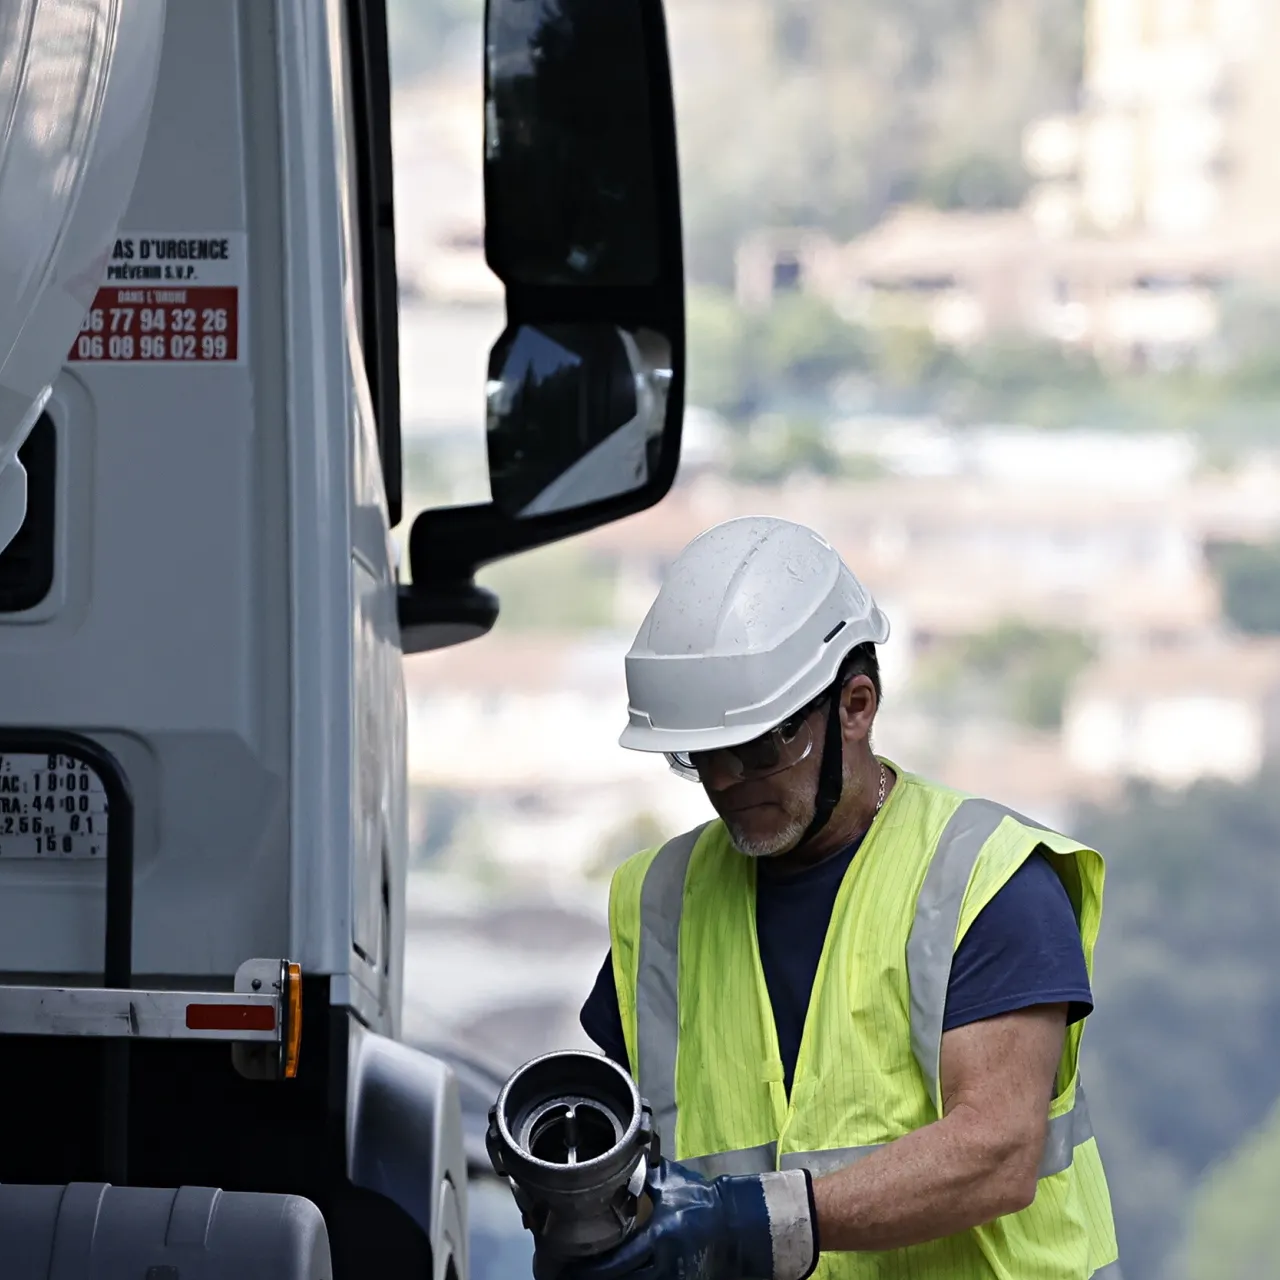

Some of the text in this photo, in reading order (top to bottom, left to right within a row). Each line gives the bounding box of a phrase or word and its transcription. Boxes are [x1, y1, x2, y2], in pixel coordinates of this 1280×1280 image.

[112, 239, 228, 260] AS D'URGENCE
[165, 265, 198, 280] S.V.P.
[109, 308, 134, 332] 77
[140, 308, 165, 332] 94
[171, 308, 196, 332] 32
[202, 308, 227, 332] 26
[78, 335, 103, 359] 06
[140, 335, 165, 359] 96
[171, 335, 196, 359] 02
[202, 335, 227, 359] 99
